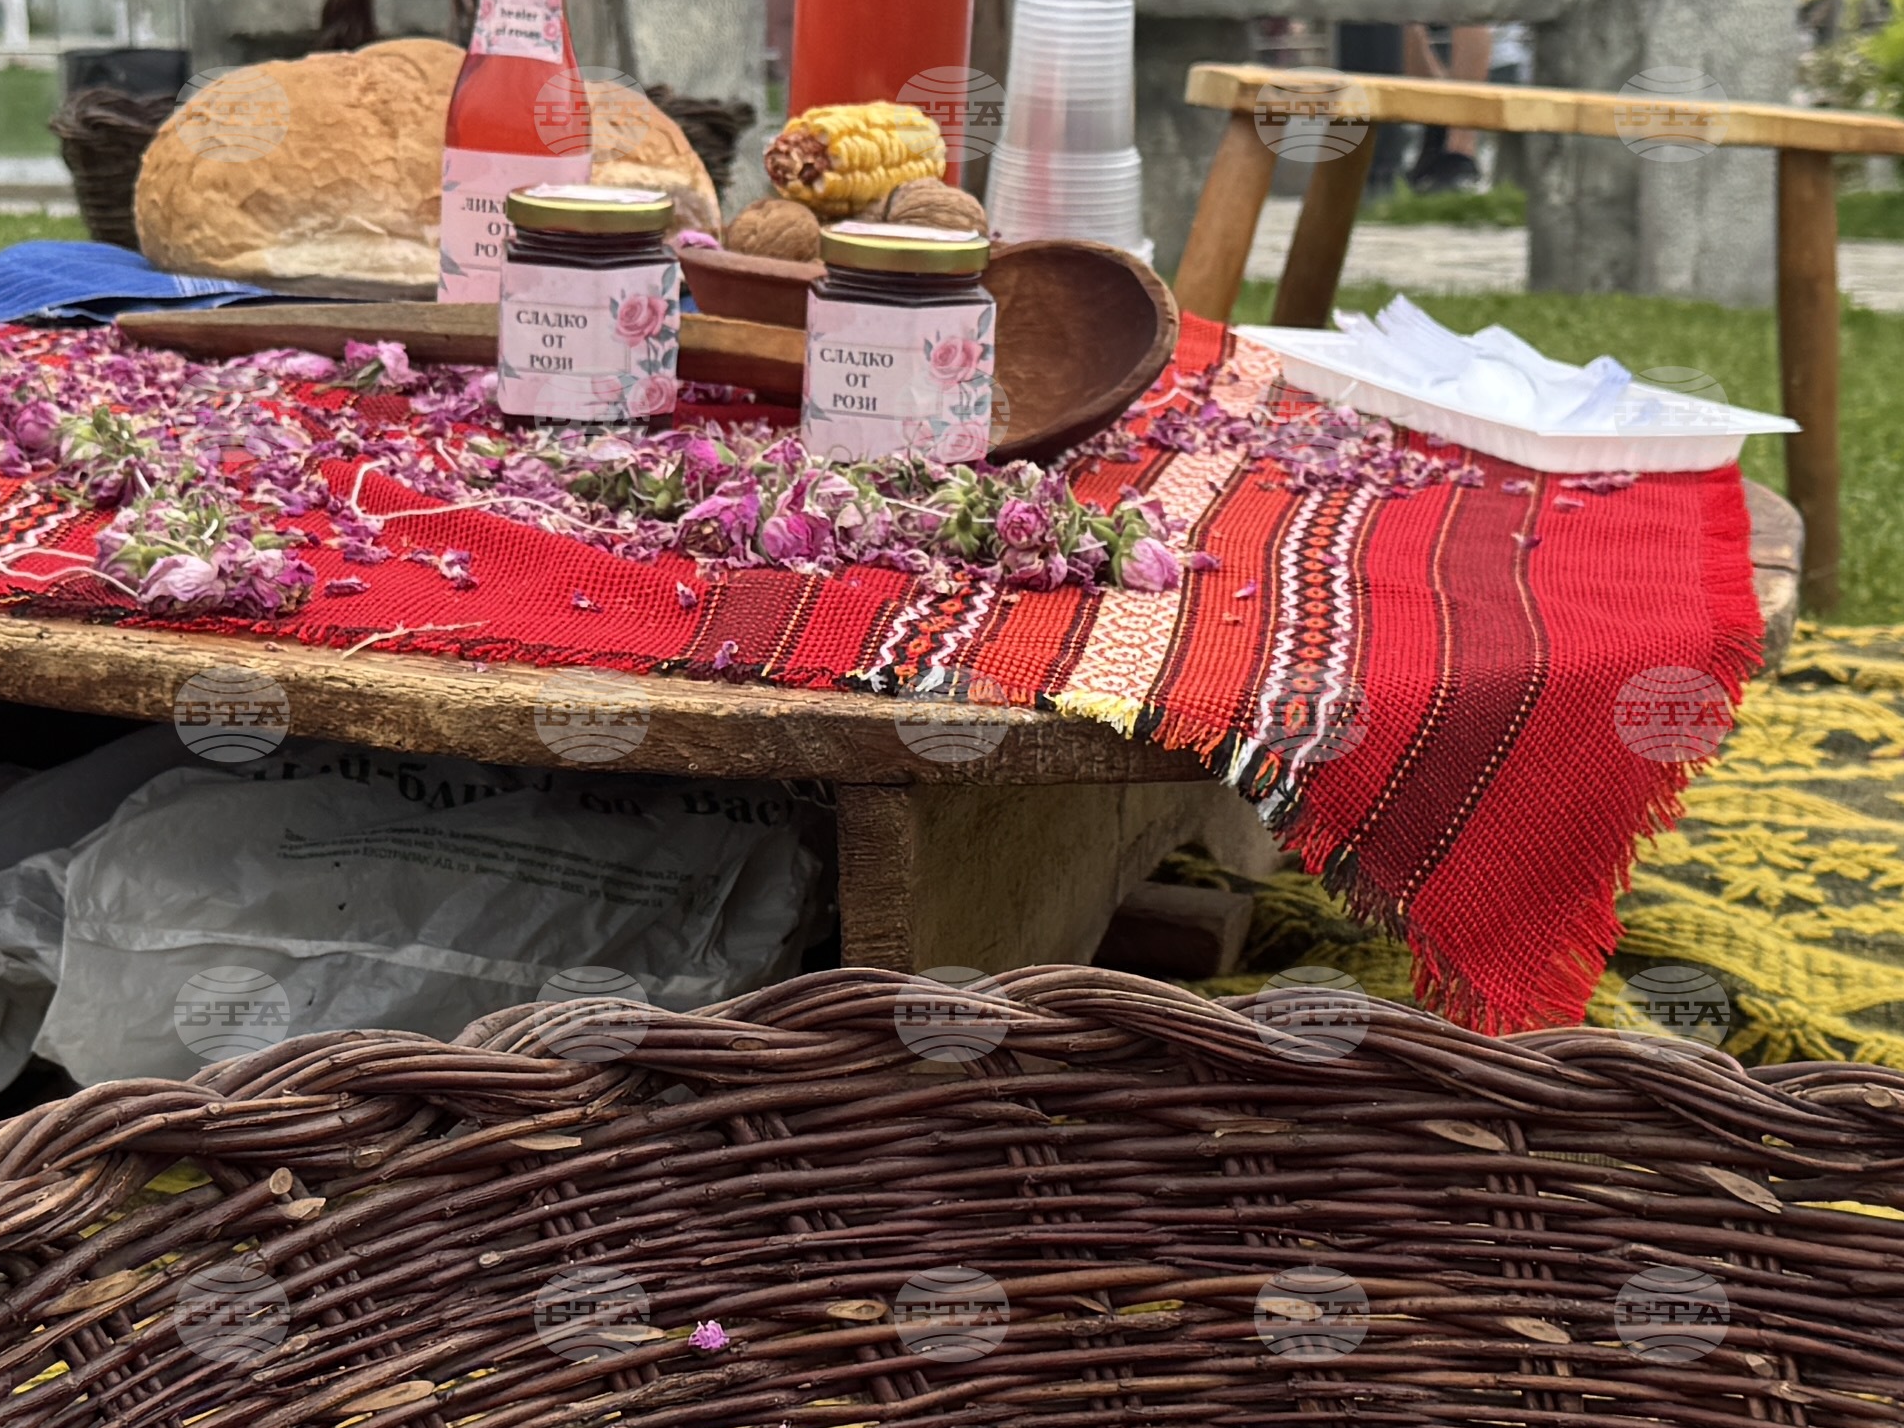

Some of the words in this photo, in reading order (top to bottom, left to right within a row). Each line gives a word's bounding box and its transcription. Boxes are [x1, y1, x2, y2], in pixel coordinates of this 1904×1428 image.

[487, 222, 513, 238] ОТ
[474, 241, 499, 258] РО
[515, 309, 588, 330] СЛАДКО
[541, 334, 565, 349] ОТ
[529, 354, 574, 372] РОЗИ
[819, 346, 894, 369] СЛАДКО
[844, 372, 871, 389] ОТ
[832, 393, 877, 413] РОЗИ
